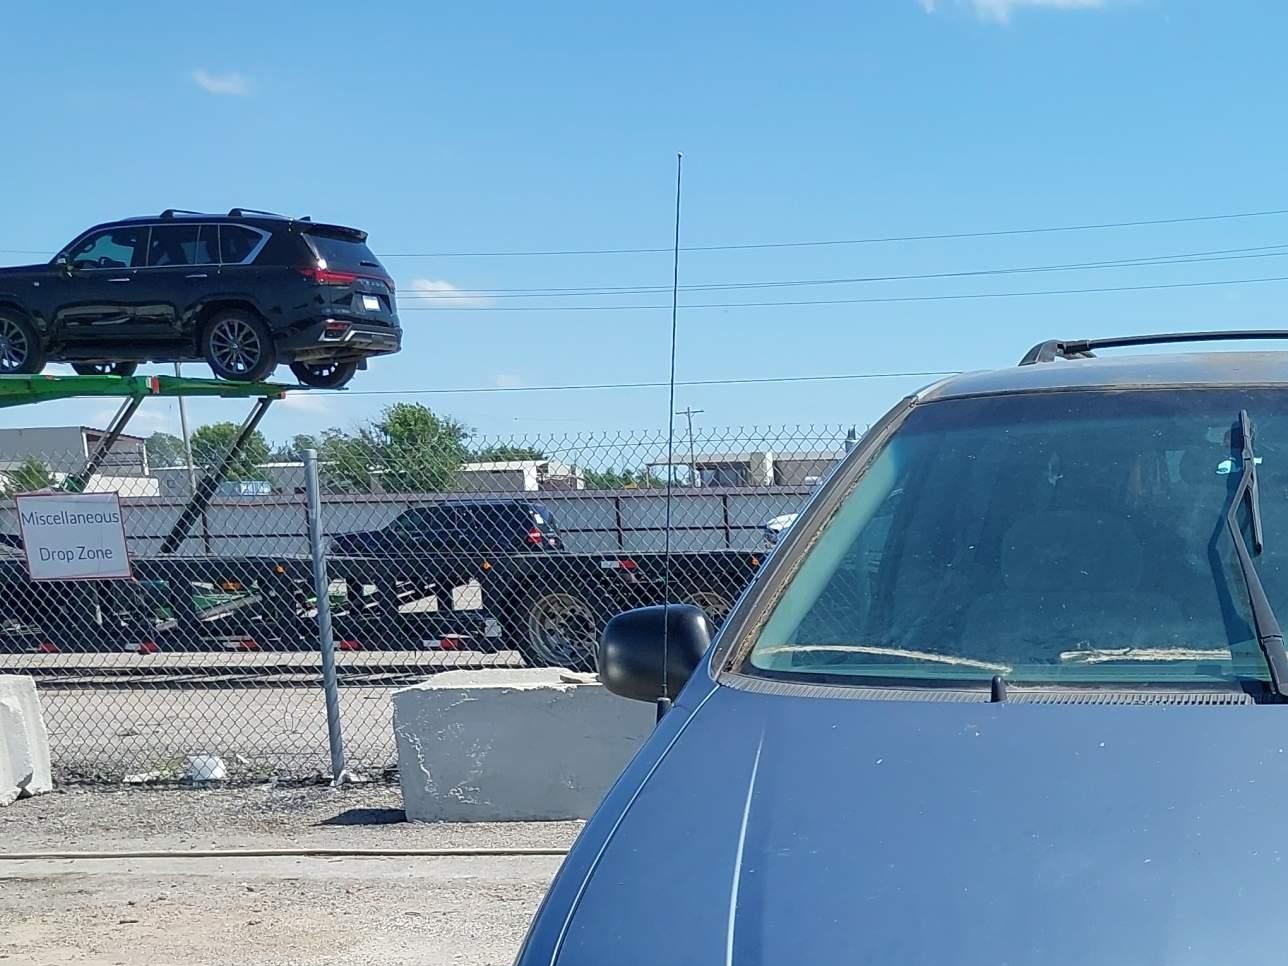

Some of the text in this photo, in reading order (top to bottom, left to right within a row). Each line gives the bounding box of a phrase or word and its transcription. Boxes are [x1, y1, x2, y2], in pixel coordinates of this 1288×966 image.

[21, 510, 120, 526] Miscellaneous
[39, 546, 113, 563] Drop Zone
